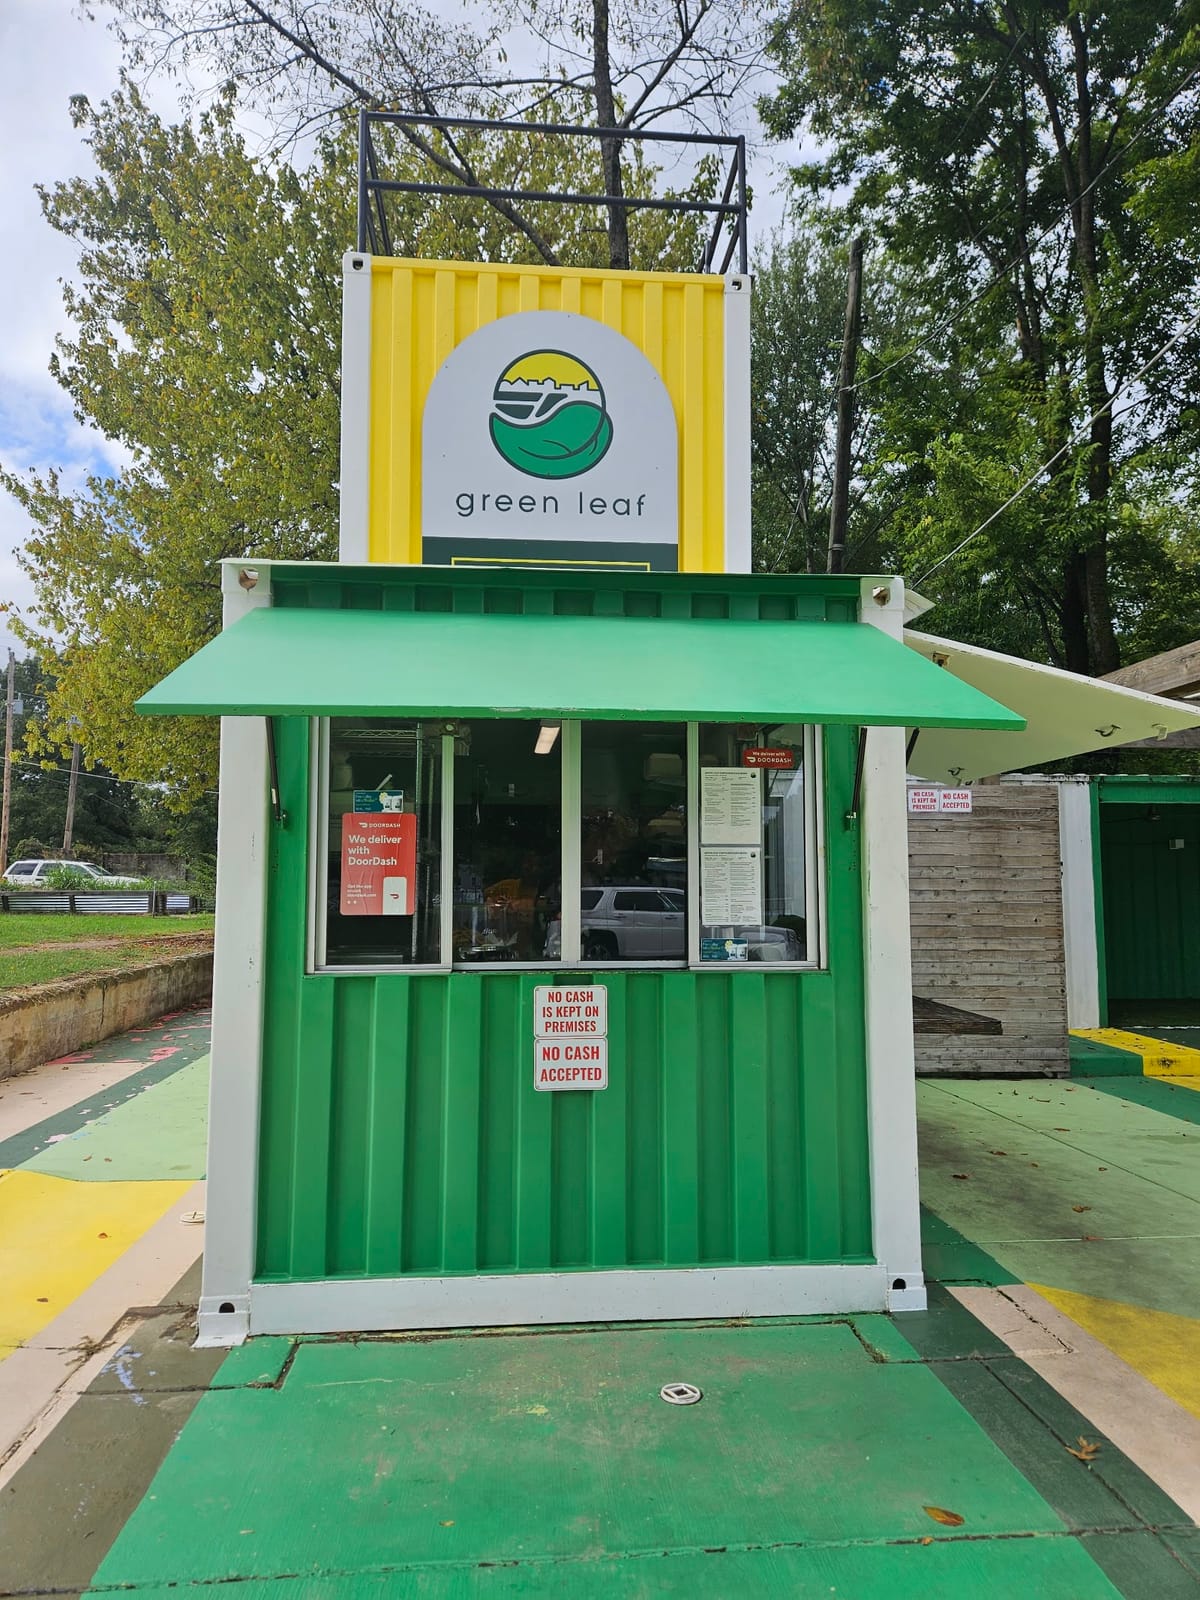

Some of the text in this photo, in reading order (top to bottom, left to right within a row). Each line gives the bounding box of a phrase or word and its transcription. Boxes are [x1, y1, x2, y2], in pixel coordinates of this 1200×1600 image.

[456, 491, 646, 517] green leaf
[348, 835, 402, 844] We deliver
[348, 846, 370, 854] with
[348, 857, 397, 866] DoorDash
[547, 991, 593, 1003] NO CASH
[542, 1005, 599, 1018] IS KEPT ON
[545, 1020, 597, 1033] PREMISES
[542, 1045, 600, 1061] NO CASH
[540, 1067, 602, 1082] ACCEPTED
